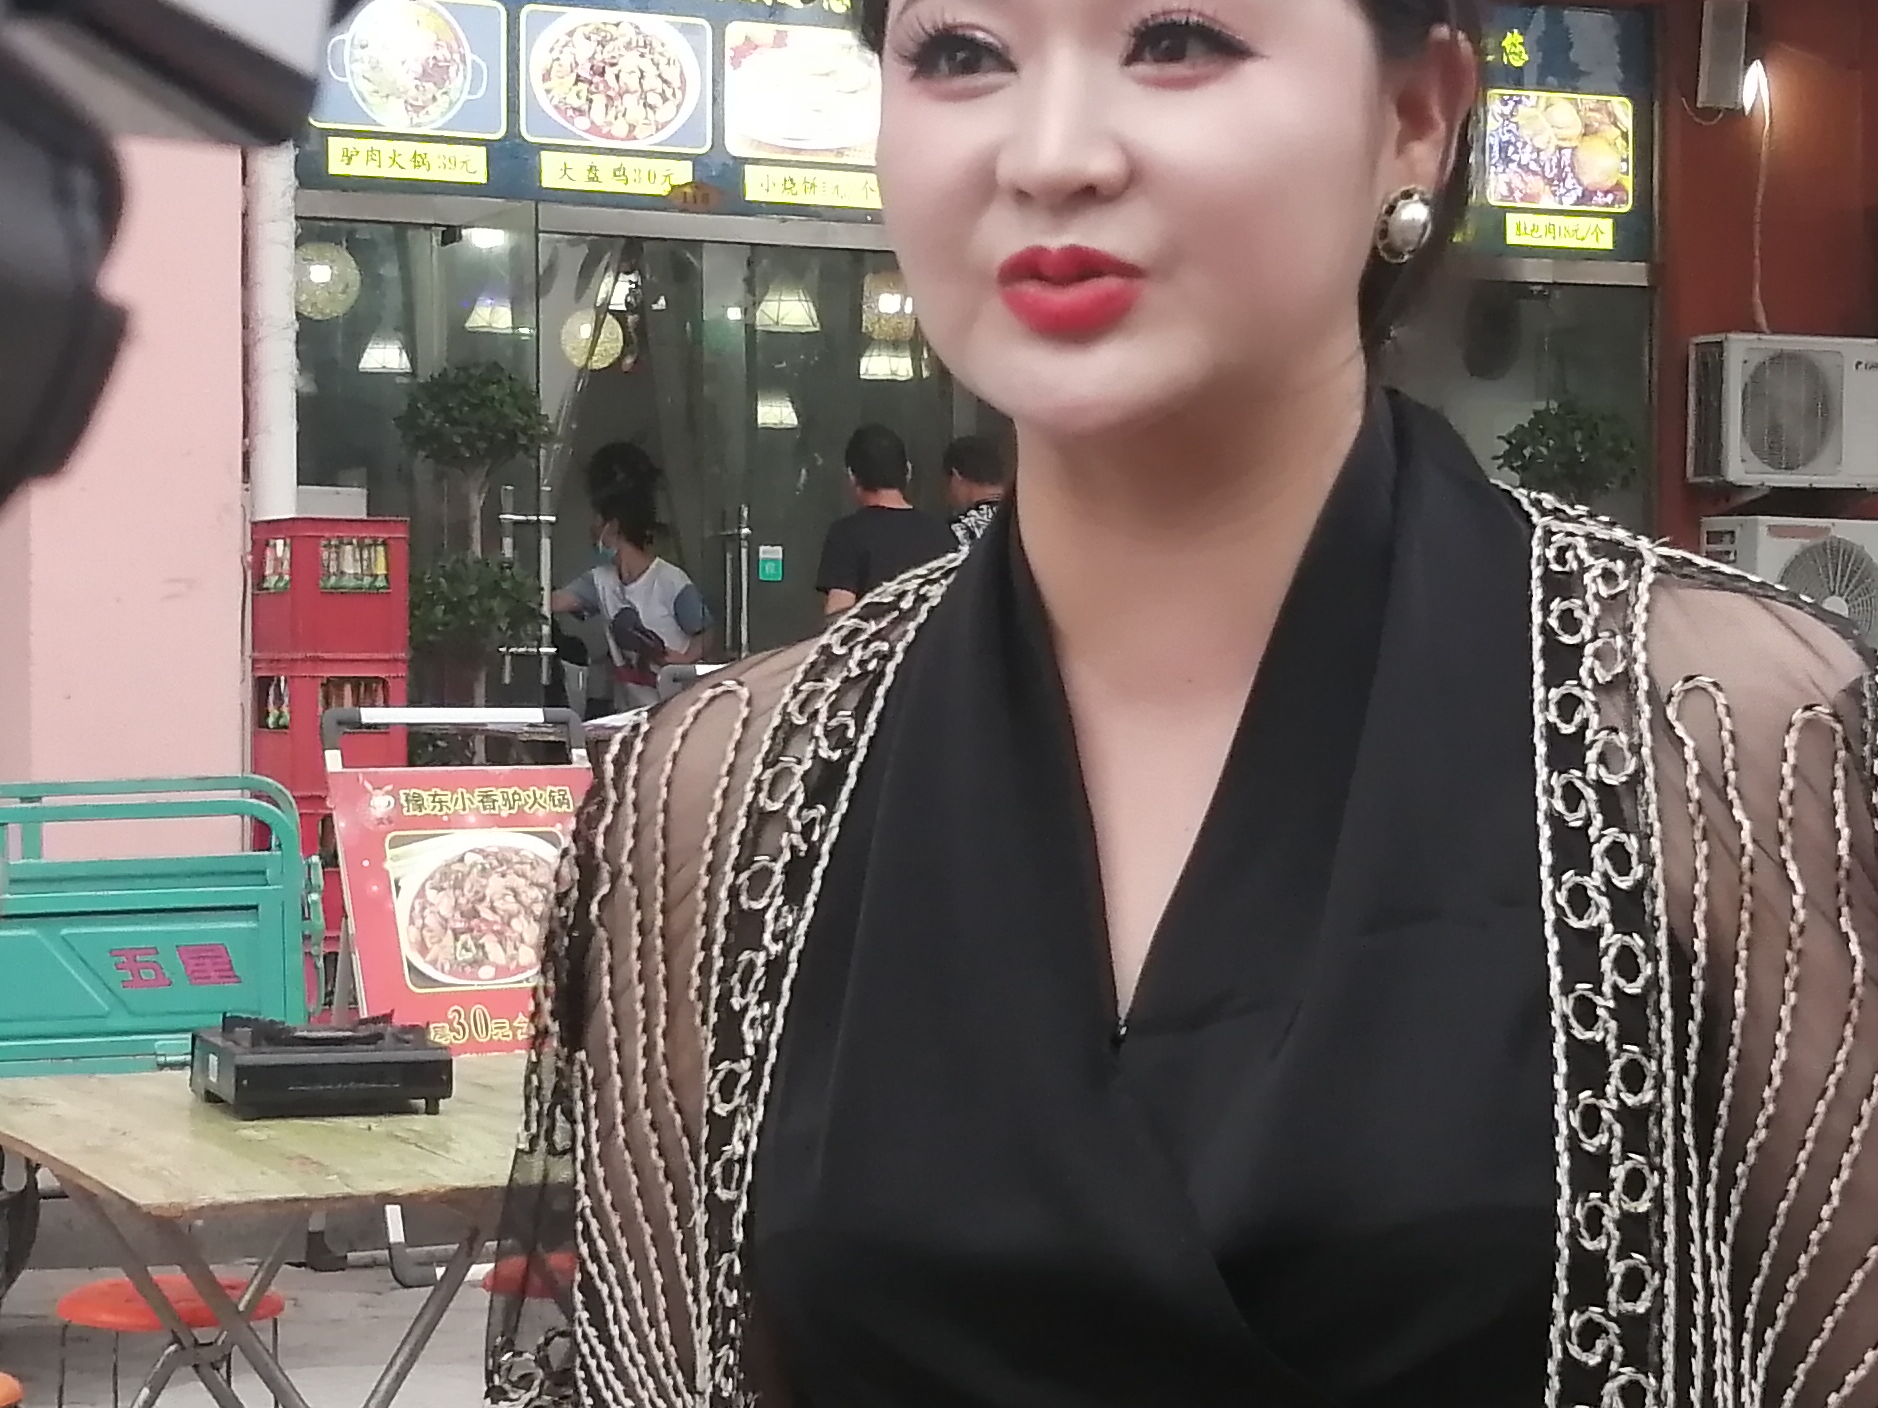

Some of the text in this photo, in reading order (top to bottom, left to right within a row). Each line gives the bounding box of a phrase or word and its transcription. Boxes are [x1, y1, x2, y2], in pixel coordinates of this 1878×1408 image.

[401, 787, 574, 815] 豫东小香驴火锅
[109, 944, 242, 989] 五星
